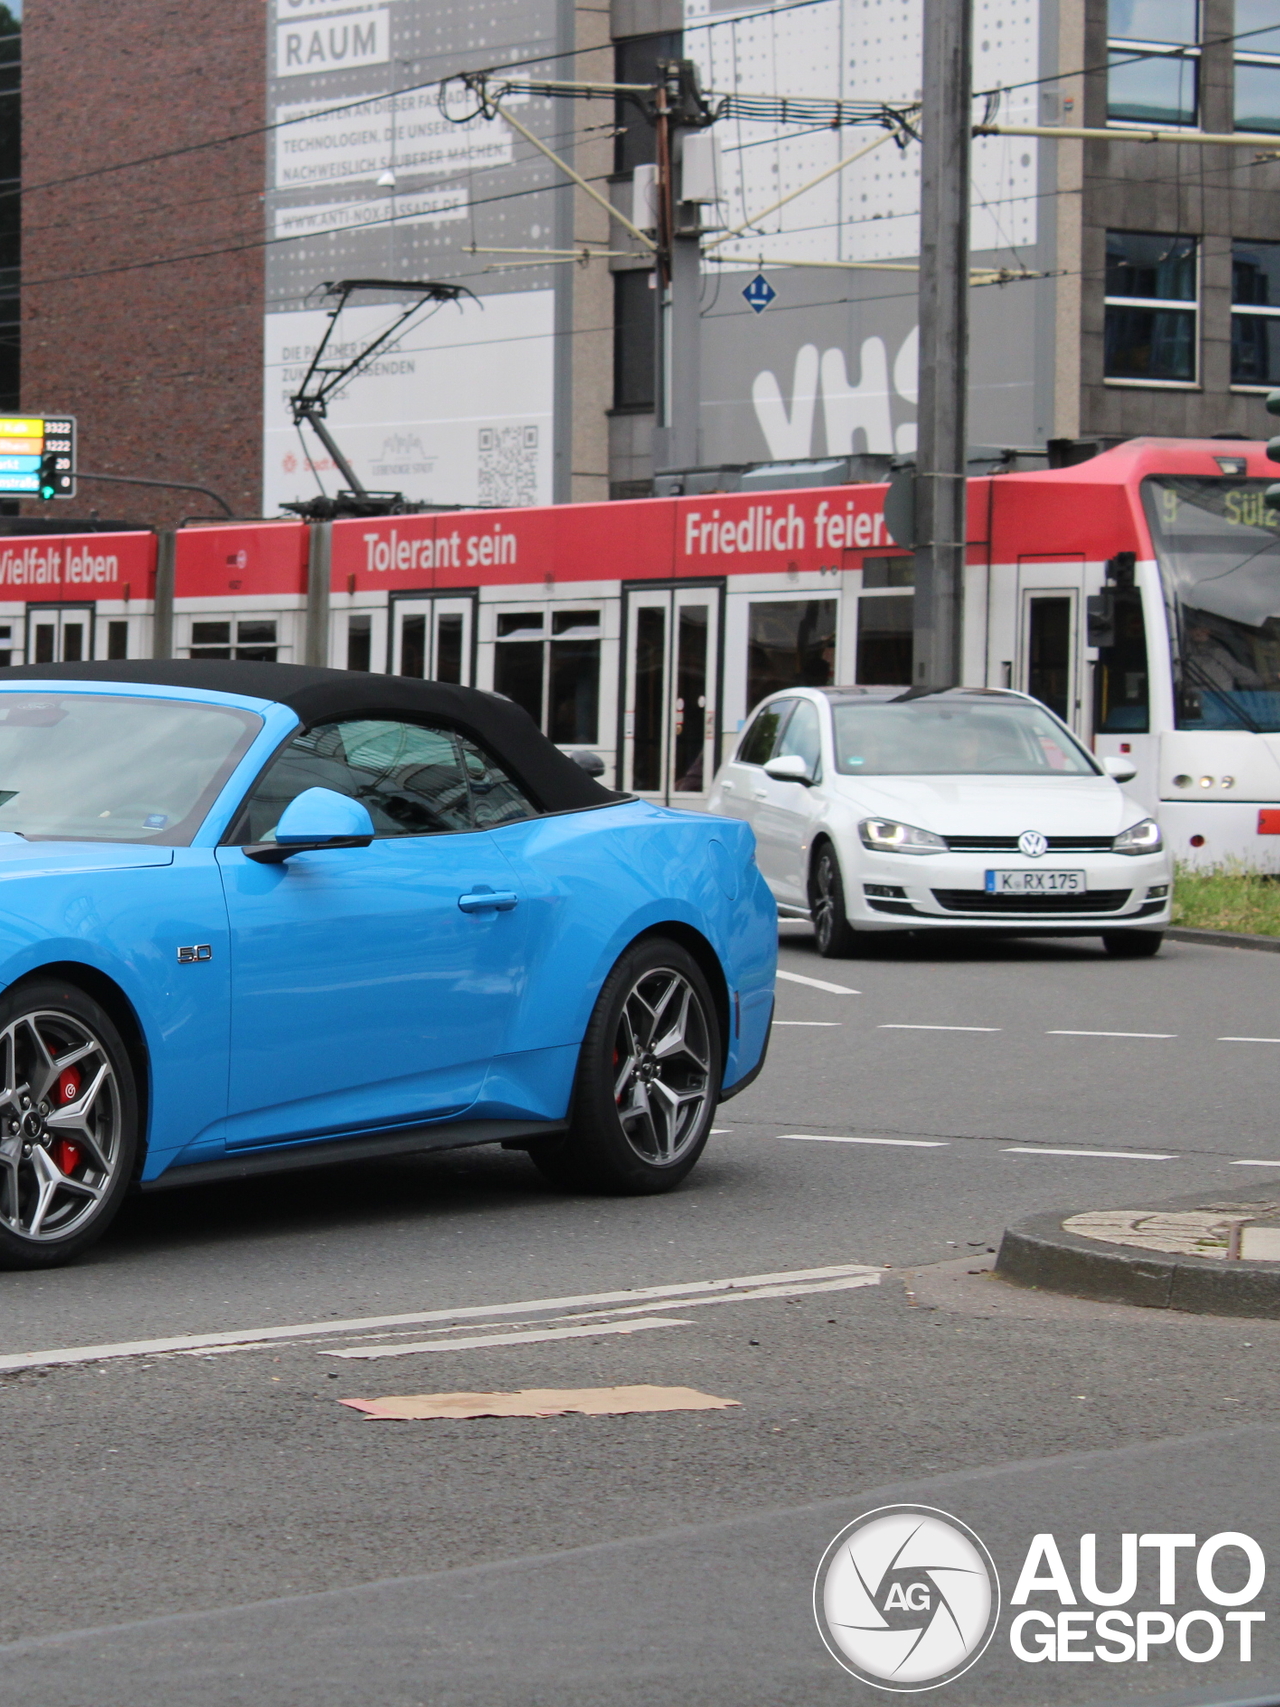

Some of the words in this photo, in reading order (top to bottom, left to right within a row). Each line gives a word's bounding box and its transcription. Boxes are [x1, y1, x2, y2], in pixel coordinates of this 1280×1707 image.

[286, 21, 377, 67] RAUM
[355, 101, 371, 117] AN
[374, 95, 419, 115] DIESER
[283, 130, 381, 154] TECHNOLOGIEN,
[408, 121, 456, 139] UNSERE
[283, 156, 376, 181] NACHWEISLICH
[380, 149, 444, 169] SAUBERER
[447, 143, 507, 163] MACHEN.
[282, 345, 302, 361] DIE
[45, 423, 71, 434] 3322
[46, 440, 71, 452] 1222
[55, 458, 71, 469] 20
[60, 476, 71, 487] 0
[1162, 489, 1178, 523] 9
[685, 502, 805, 555] Friedlich
[814, 501, 894, 550] feier
[363, 529, 461, 572] Tolerant
[466, 523, 517, 569] sein
[64, 546, 118, 583] leben
[1001, 874, 1013, 889] K
[1024, 874, 1045, 889] RX
[1049, 874, 1078, 889] 175
[177, 944, 212, 964] 5.0
